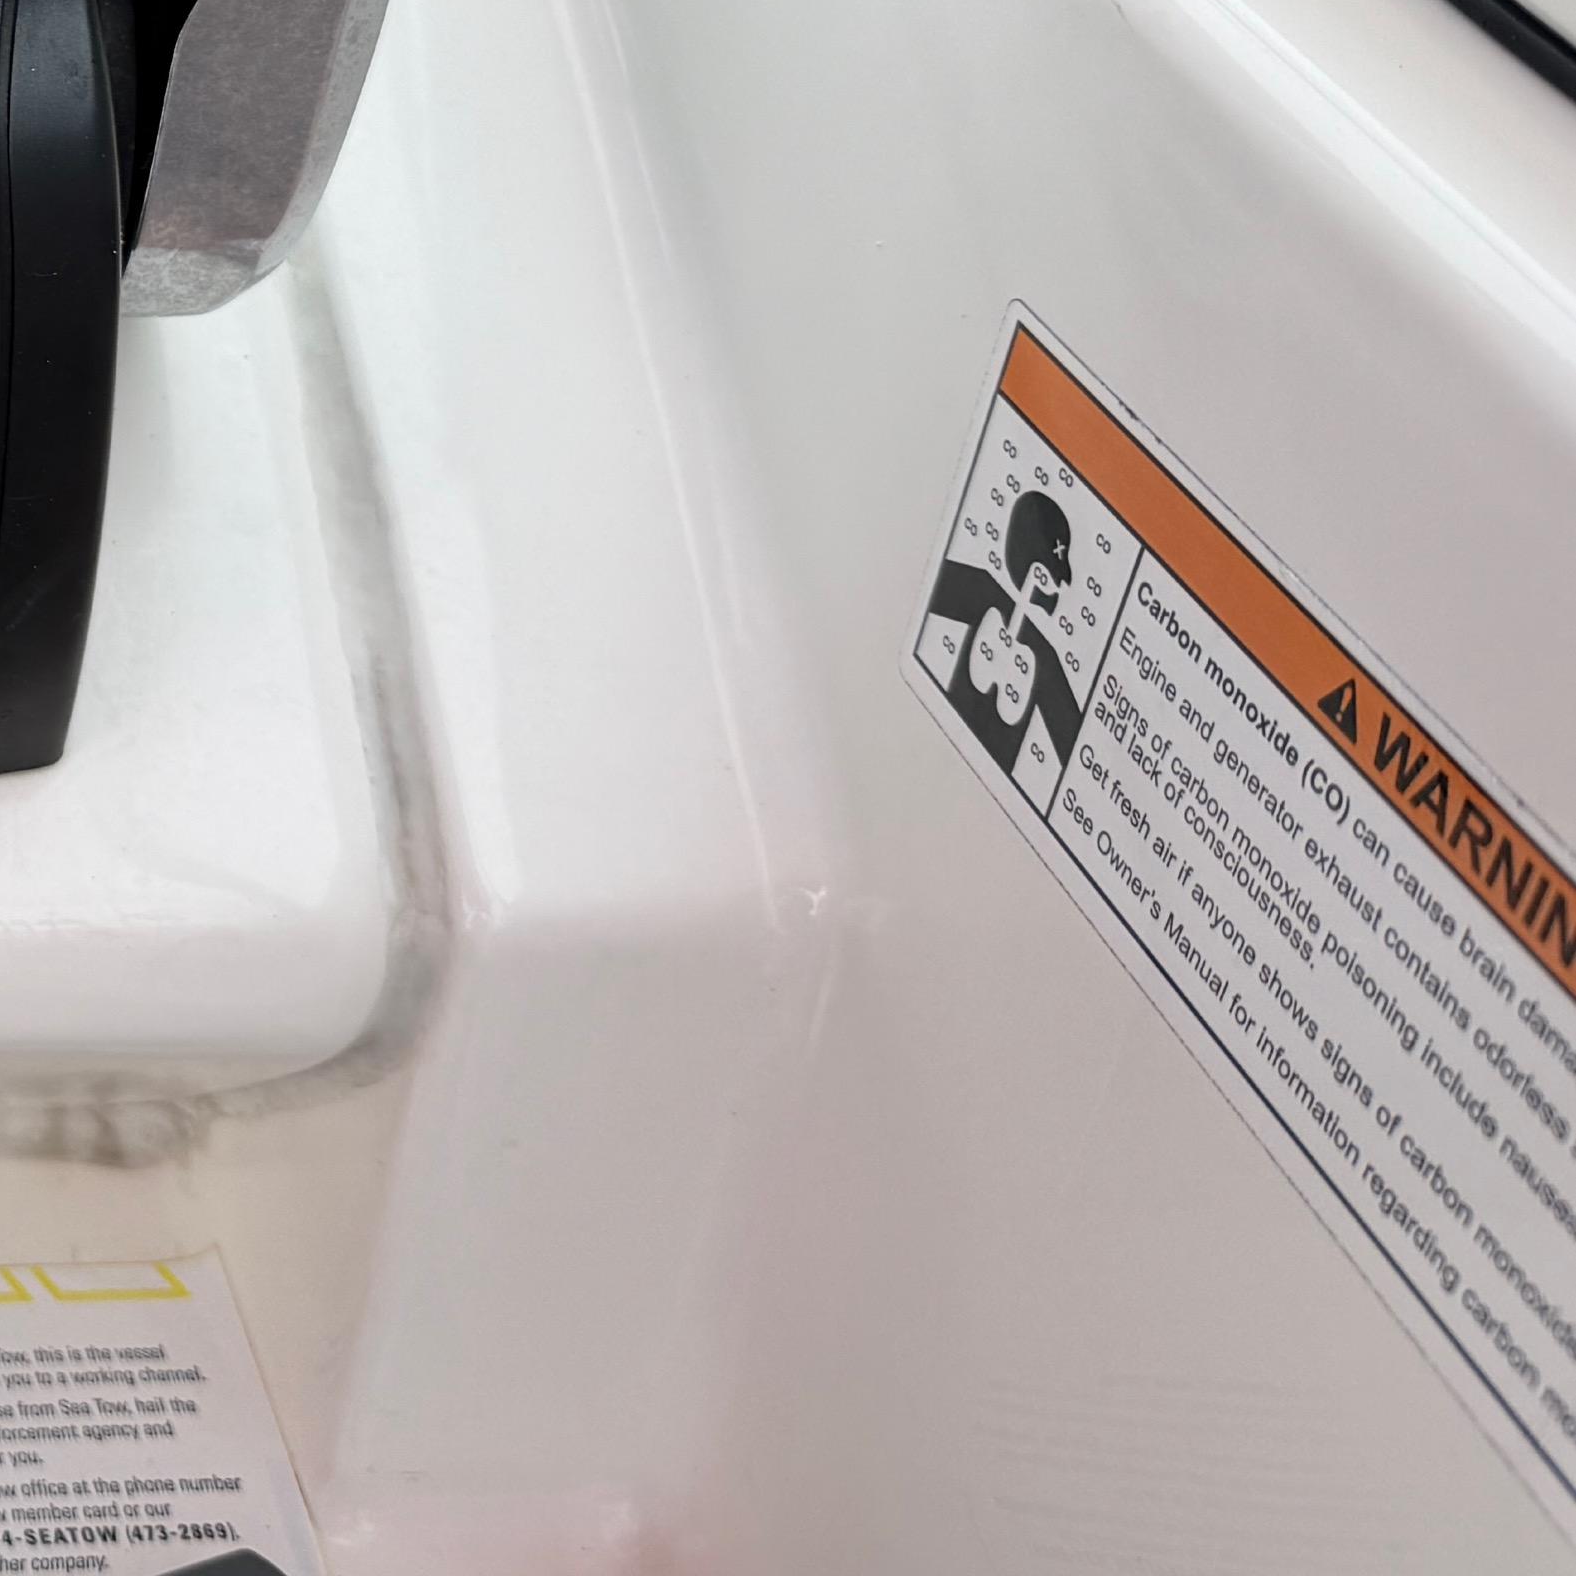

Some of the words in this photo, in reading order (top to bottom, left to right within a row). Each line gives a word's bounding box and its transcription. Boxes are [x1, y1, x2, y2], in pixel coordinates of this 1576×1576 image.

[1003, 440, 1017, 458] CO
[1035, 466, 1049, 485] CO
[1059, 467, 1074, 487] CO
[1096, 534, 1111, 554] CO
[1087, 576, 1102, 596] CO
[1081, 606, 1095, 626] CO
[943, 636, 955, 653] CO
[1031, 743, 1044, 762] CO
[1136, 579, 1203, 665] Carbon
[1202, 655, 1300, 769] monoxide
[1300, 757, 1351, 829] (CO)
[1351, 816, 1391, 870] can
[1392, 861, 1457, 939] cause
[1457, 925, 1517, 1004] brain
[1092, 696, 1129, 746] and
[1125, 731, 1164, 790] lack
[1162, 780, 1186, 810] of
[1182, 803, 1324, 971] consciousness.
[1118, 624, 1177, 704] Engine
[1177, 697, 1216, 745] and
[1211, 736, 1305, 843] generator
[1303, 836, 1383, 934] exhaust
[1382, 925, 1472, 1033] contains
[1472, 1026, 1570, 1144] odorless
[1101, 672, 1149, 739] Signs
[1149, 732, 1173, 762] of
[1169, 754, 1231, 834] carbon
[1230, 823, 1321, 937] monoxide
[1320, 929, 1420, 1054] poisoning
[1419, 1036, 1499, 1141] include
[1078, 742, 1110, 791] Get
[1108, 778, 1152, 843] fresh
[1150, 834, 1178, 869] air
[1176, 857, 1195, 888] if
[1190, 881, 1257, 968] anyone
[1257, 961, 1319, 1044] shows
[1319, 1036, 1374, 1110] signs
[1374, 1103, 1403, 1138] of
[1398, 1133, 1474, 1229] carbon
[1061, 786, 1094, 837] See
[1095, 828, 1162, 922] Owner's
[1162, 909, 1230, 1004] Manual
[1227, 991, 1257, 1036] for
[1254, 1024, 1361, 1168] information
[1360, 1161, 1462, 1296] regarding
[1460, 1287, 1541, 1390] carbon
[15, 1400, 59, 1420] from
[57, 1398, 95, 1419] Sea
[133, 1395, 169, 1416] hail
[168, 1396, 198, 1415] the
[81, 1423, 141, 1442] agency
[142, 1419, 176, 1439] and
[19, 1478, 70, 1499] office
[71, 1478, 92, 1498] at
[91, 1476, 123, 1497] the
[123, 1476, 177, 1497] phone
[177, 1474, 243, 1493] number
[10, 1502, 81, 1524] member
[81, 1500, 122, 1521] card
[122, 1503, 142, 1520] or
[143, 1502, 173, 1521] our
